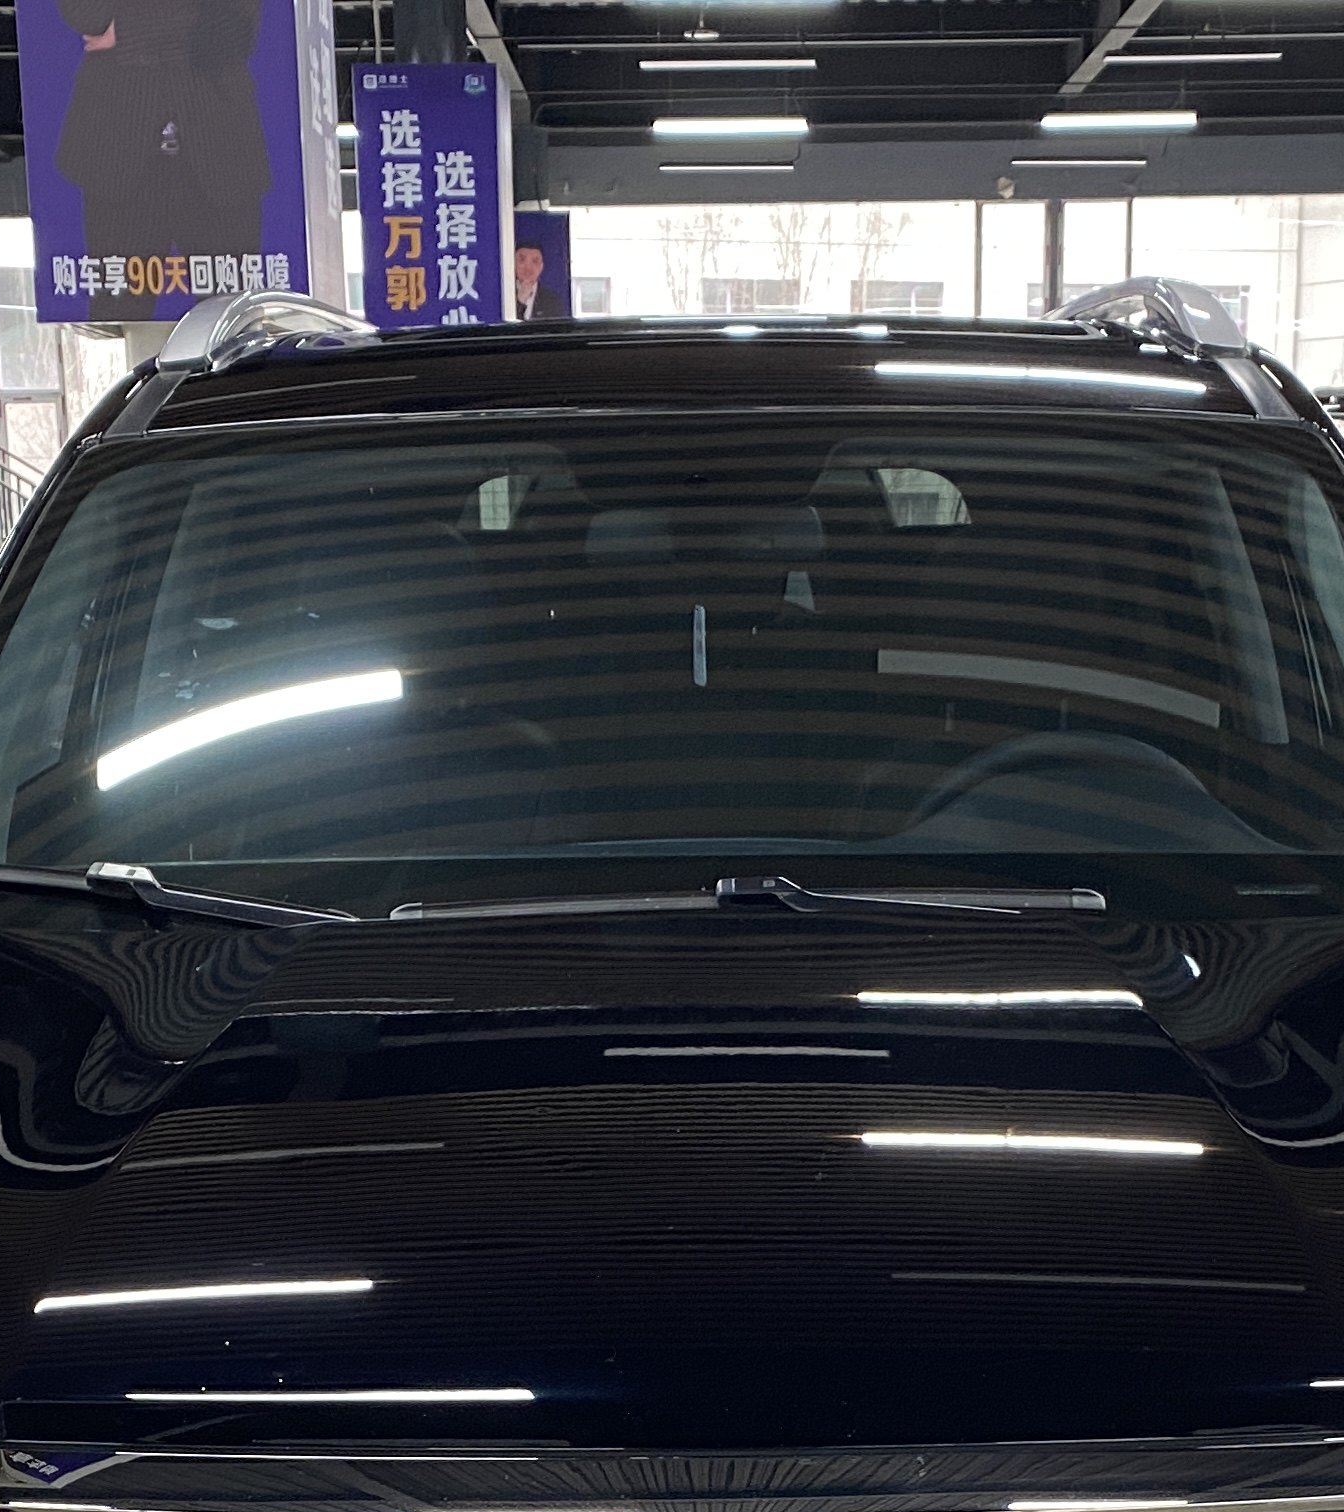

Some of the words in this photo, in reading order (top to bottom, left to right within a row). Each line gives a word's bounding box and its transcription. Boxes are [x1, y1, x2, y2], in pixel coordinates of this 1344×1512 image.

[379, 109, 427, 311] 选择万郭
[52, 252, 291, 296] 购车享90天回购保障
